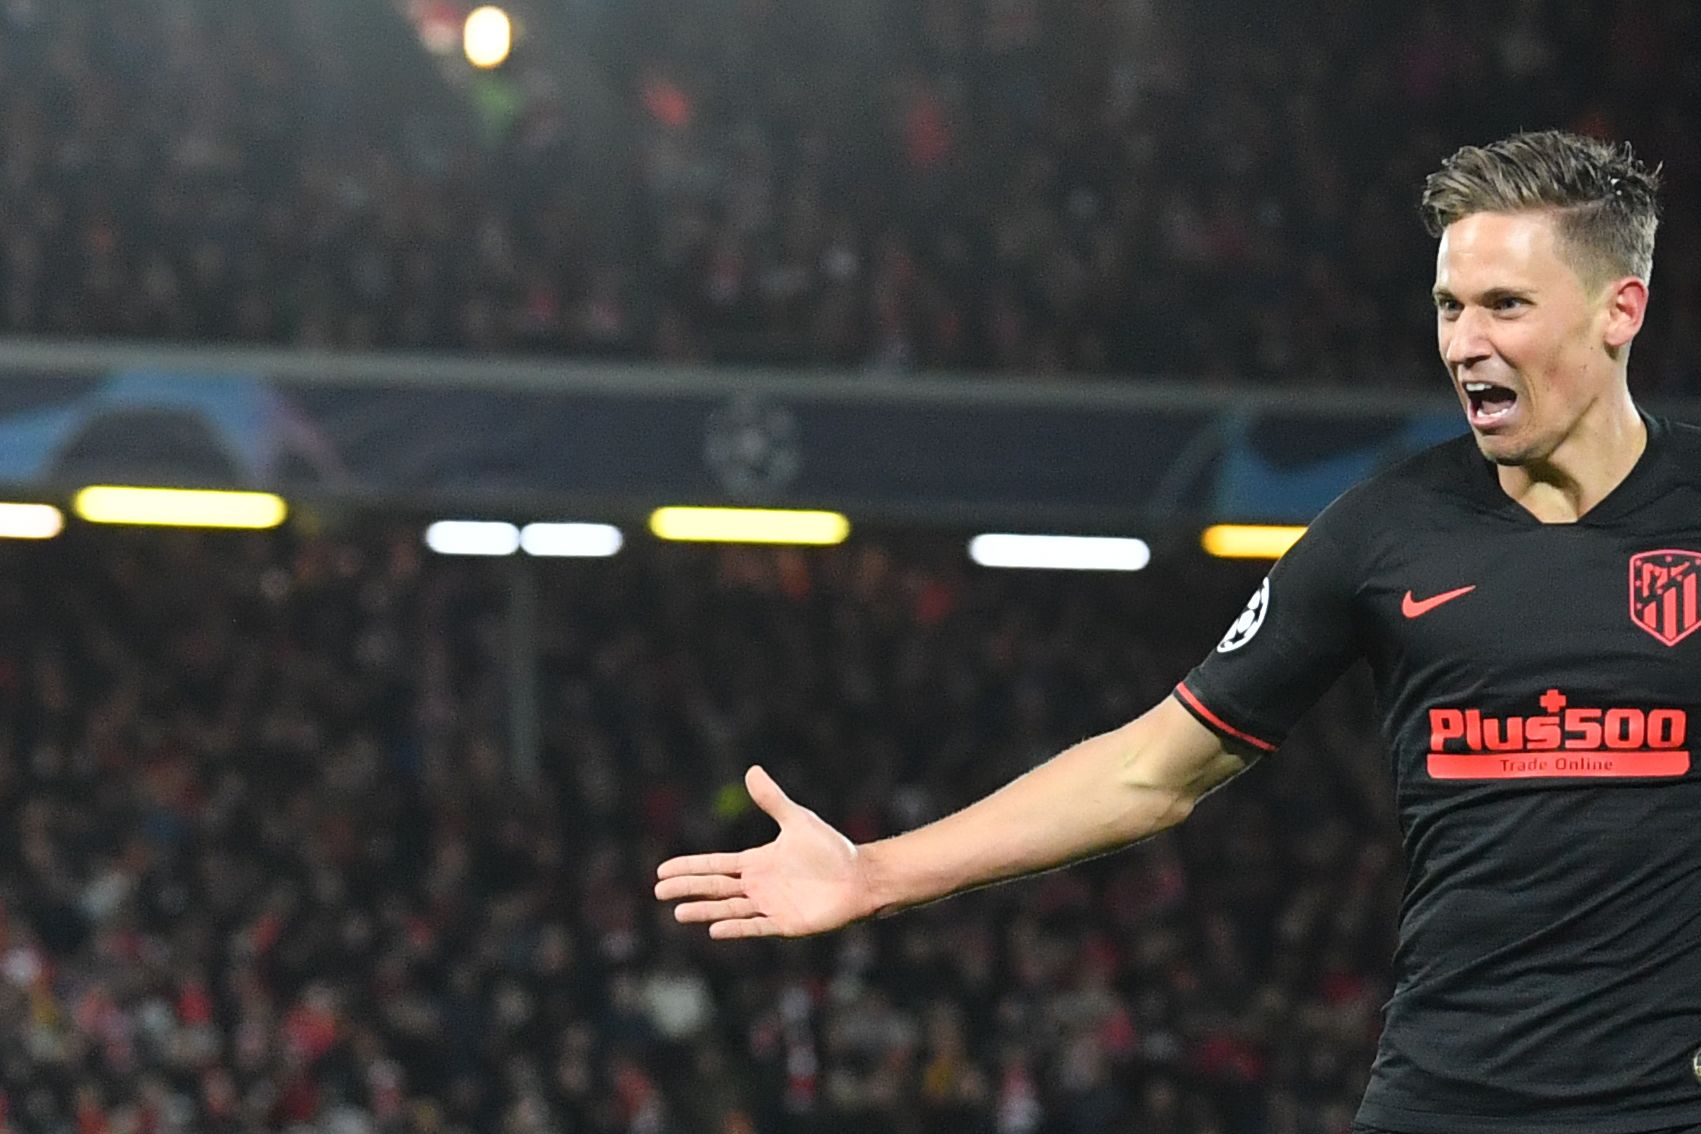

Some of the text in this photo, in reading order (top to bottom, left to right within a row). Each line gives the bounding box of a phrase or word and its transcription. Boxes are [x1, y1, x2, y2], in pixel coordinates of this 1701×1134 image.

[1428, 706, 1687, 751] Plus500
[1499, 756, 1614, 773] Trade Online
